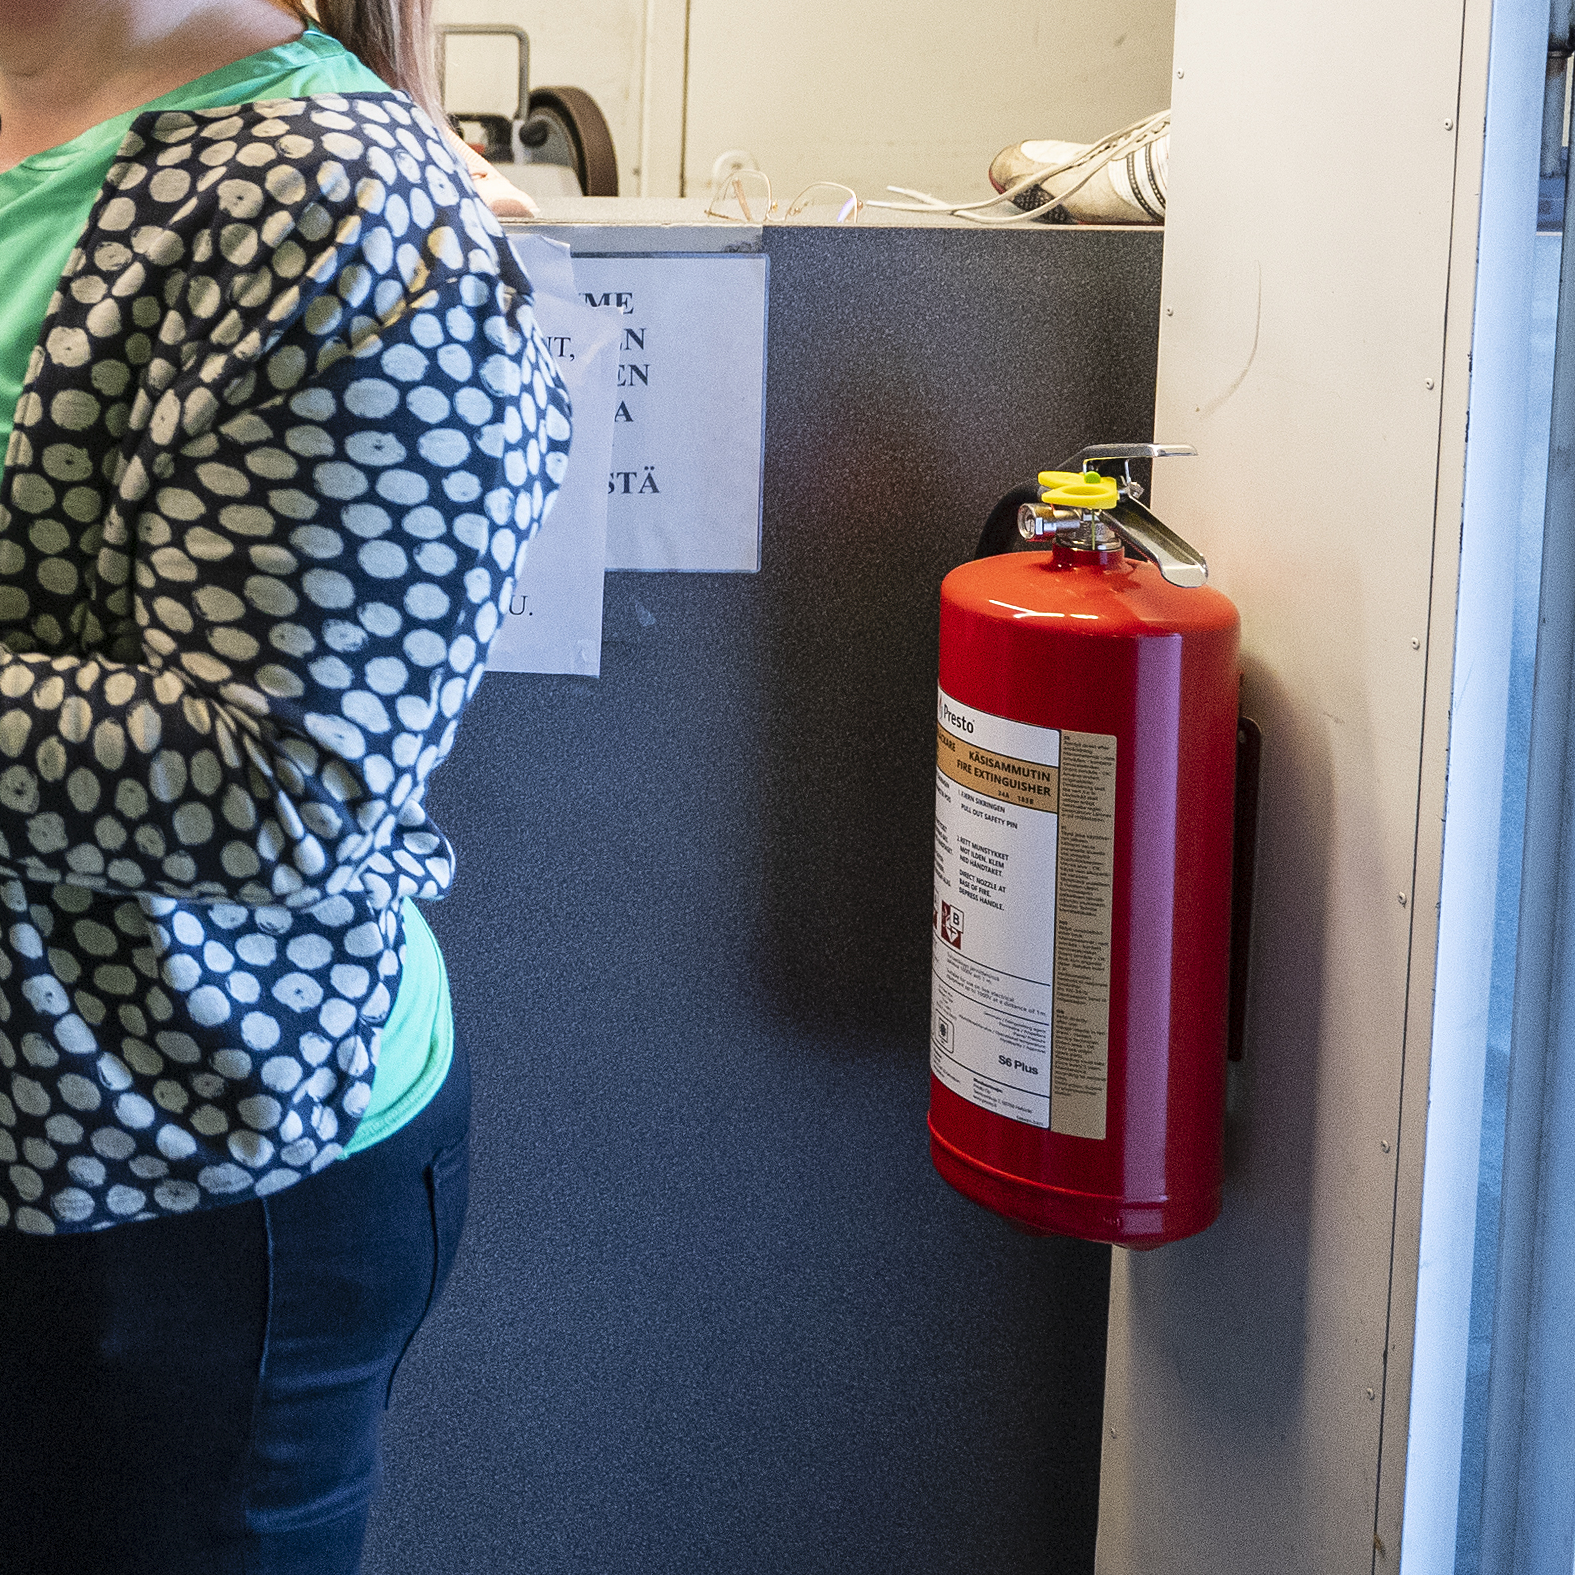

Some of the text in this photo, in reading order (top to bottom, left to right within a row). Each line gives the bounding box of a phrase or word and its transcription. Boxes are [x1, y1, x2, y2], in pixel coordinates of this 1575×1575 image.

[943, 703, 974, 734] Presto
[956, 759, 972, 775] FIRE
[974, 768, 1051, 797] EXTINGUISHER
[969, 750, 1051, 782] KÄSISAMMUTIN
[960, 803, 1018, 830] PULL OUT SAFETY PIN
[976, 876, 997, 891] NOZZLE
[952, 912, 960, 925] B
[998, 1054, 1039, 1076] S6 Plus
